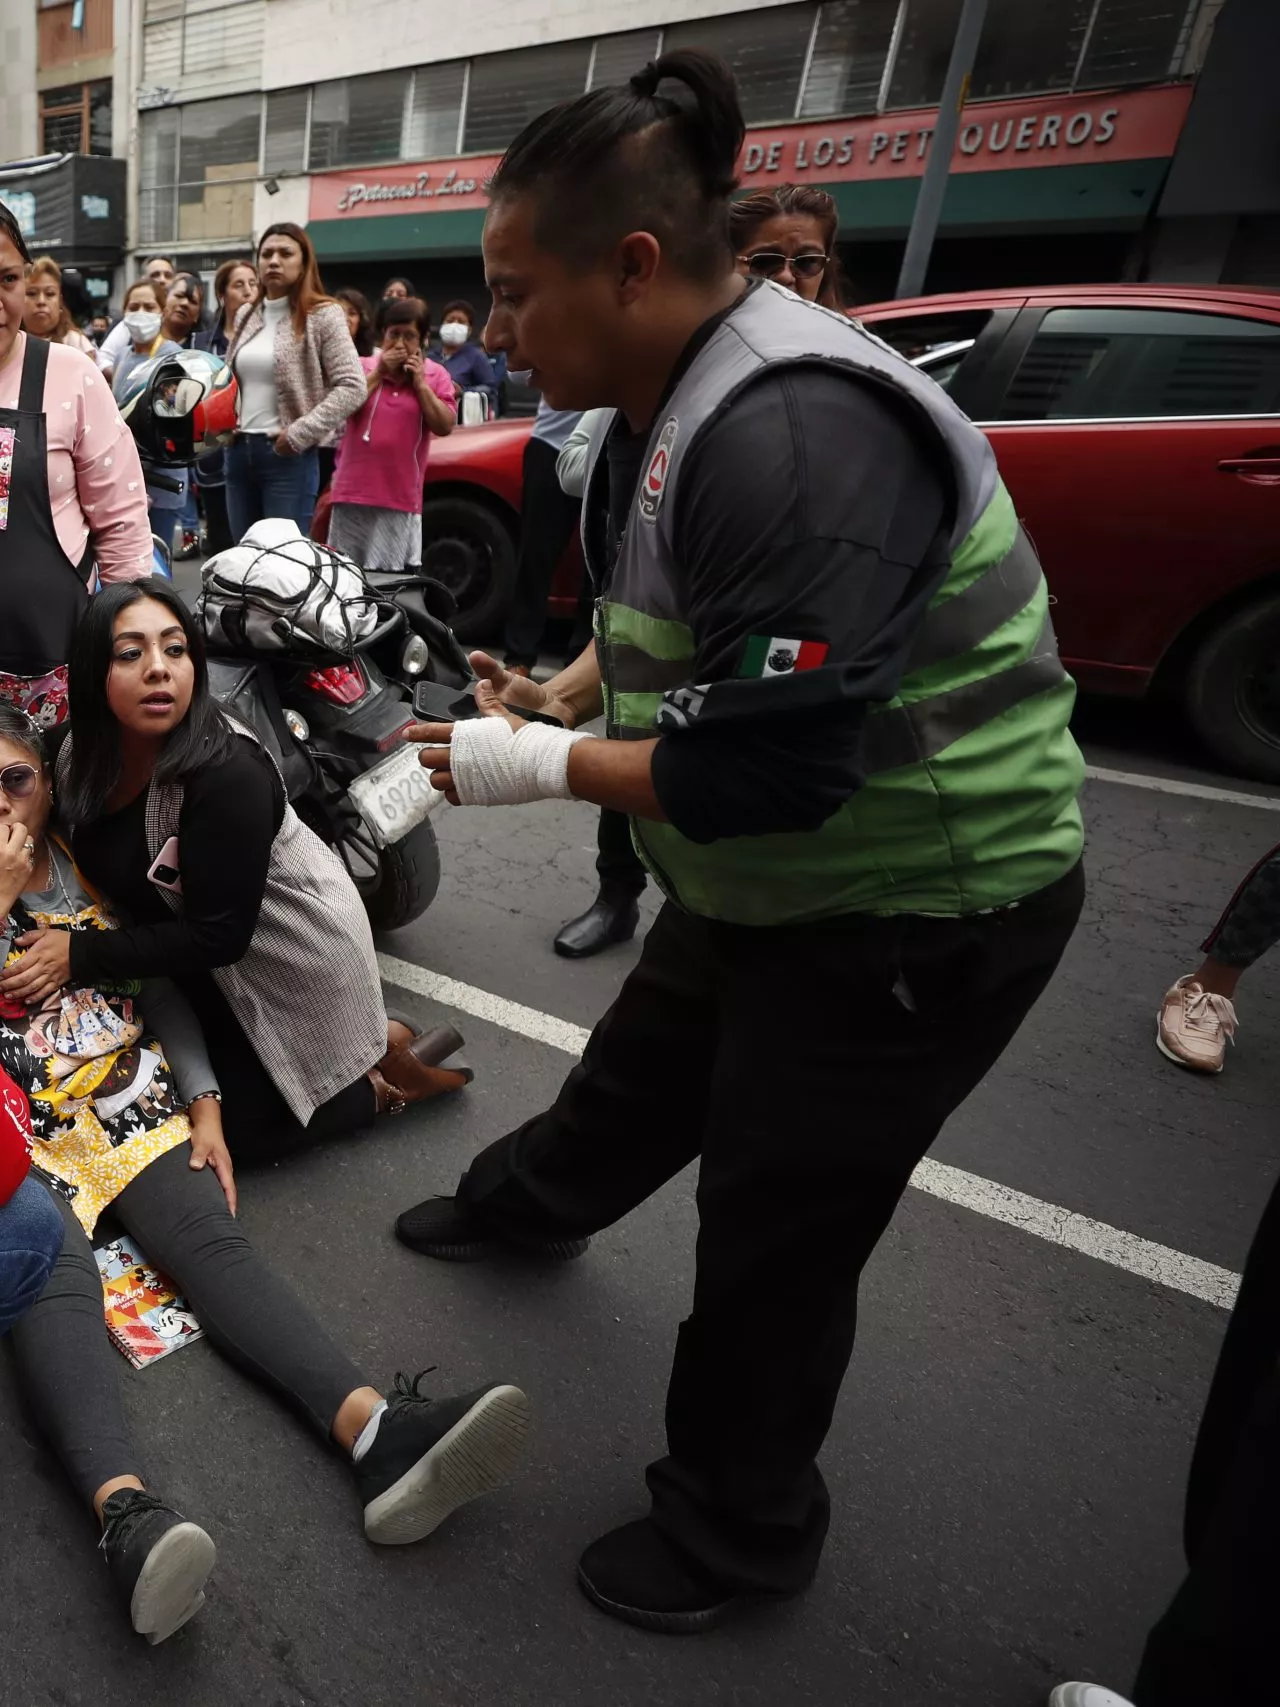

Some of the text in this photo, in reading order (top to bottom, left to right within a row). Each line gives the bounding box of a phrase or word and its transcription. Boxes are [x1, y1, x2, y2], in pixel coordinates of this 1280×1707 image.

[743, 108, 1118, 172] DE LOS PETQUEROS
[379, 770, 431, 820] 6928
